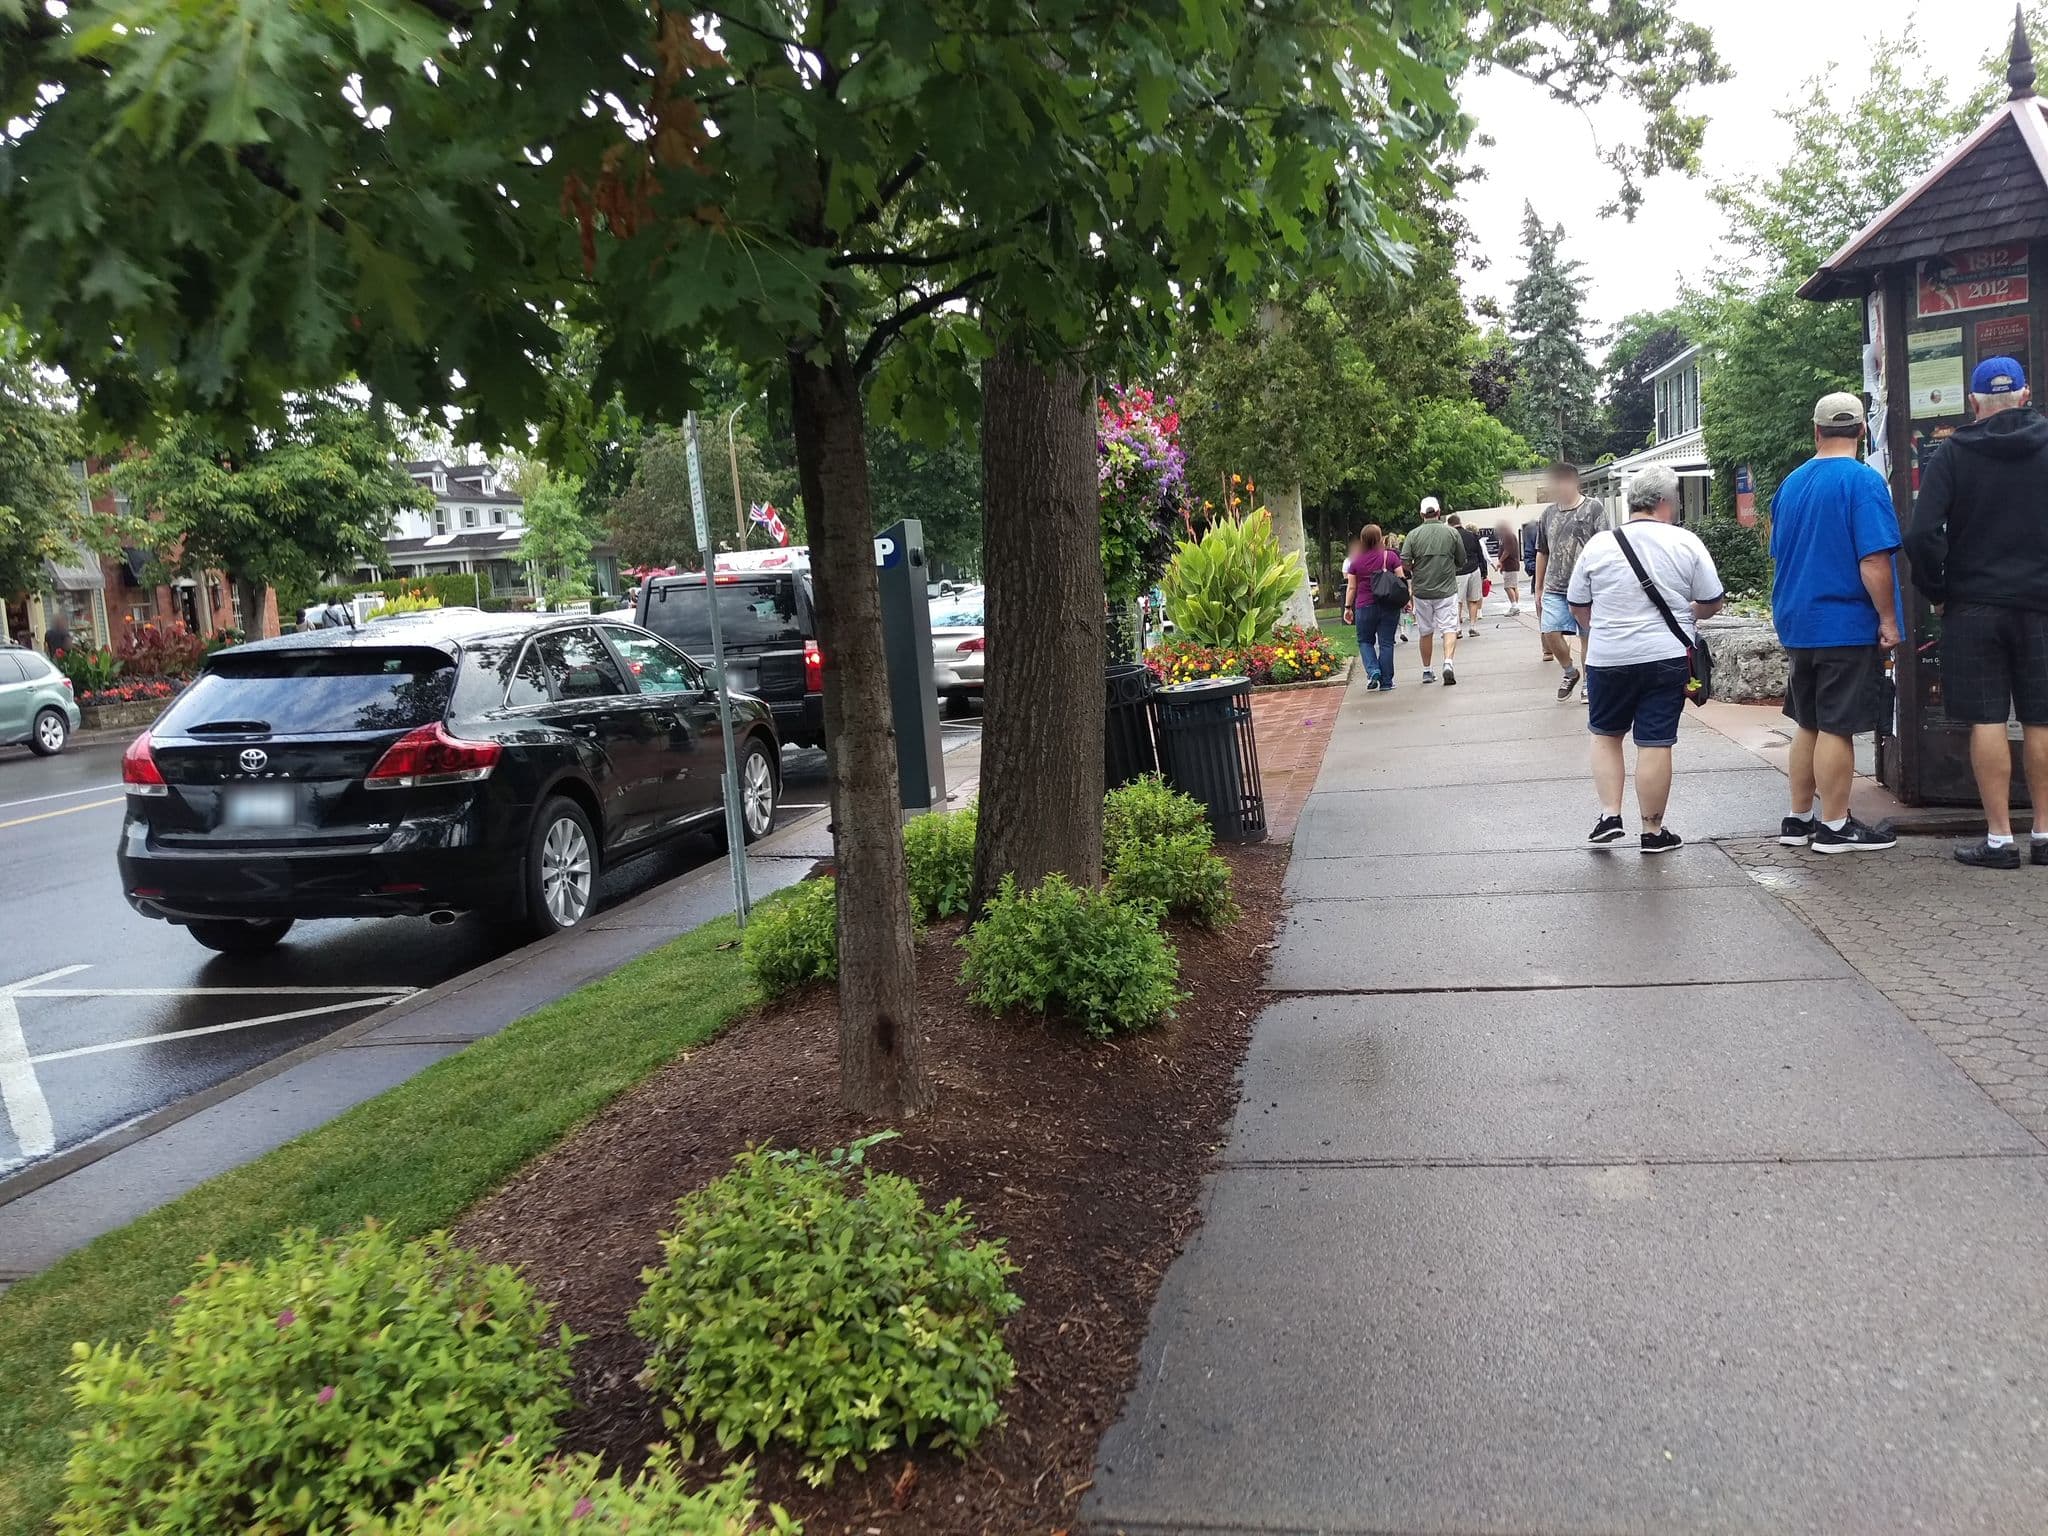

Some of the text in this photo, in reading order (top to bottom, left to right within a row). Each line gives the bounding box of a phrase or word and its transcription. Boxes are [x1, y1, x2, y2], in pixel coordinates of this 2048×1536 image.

[1968, 249, 2009, 271] 1812
[1968, 279, 2009, 299] 2012
[874, 538, 895, 566] P
